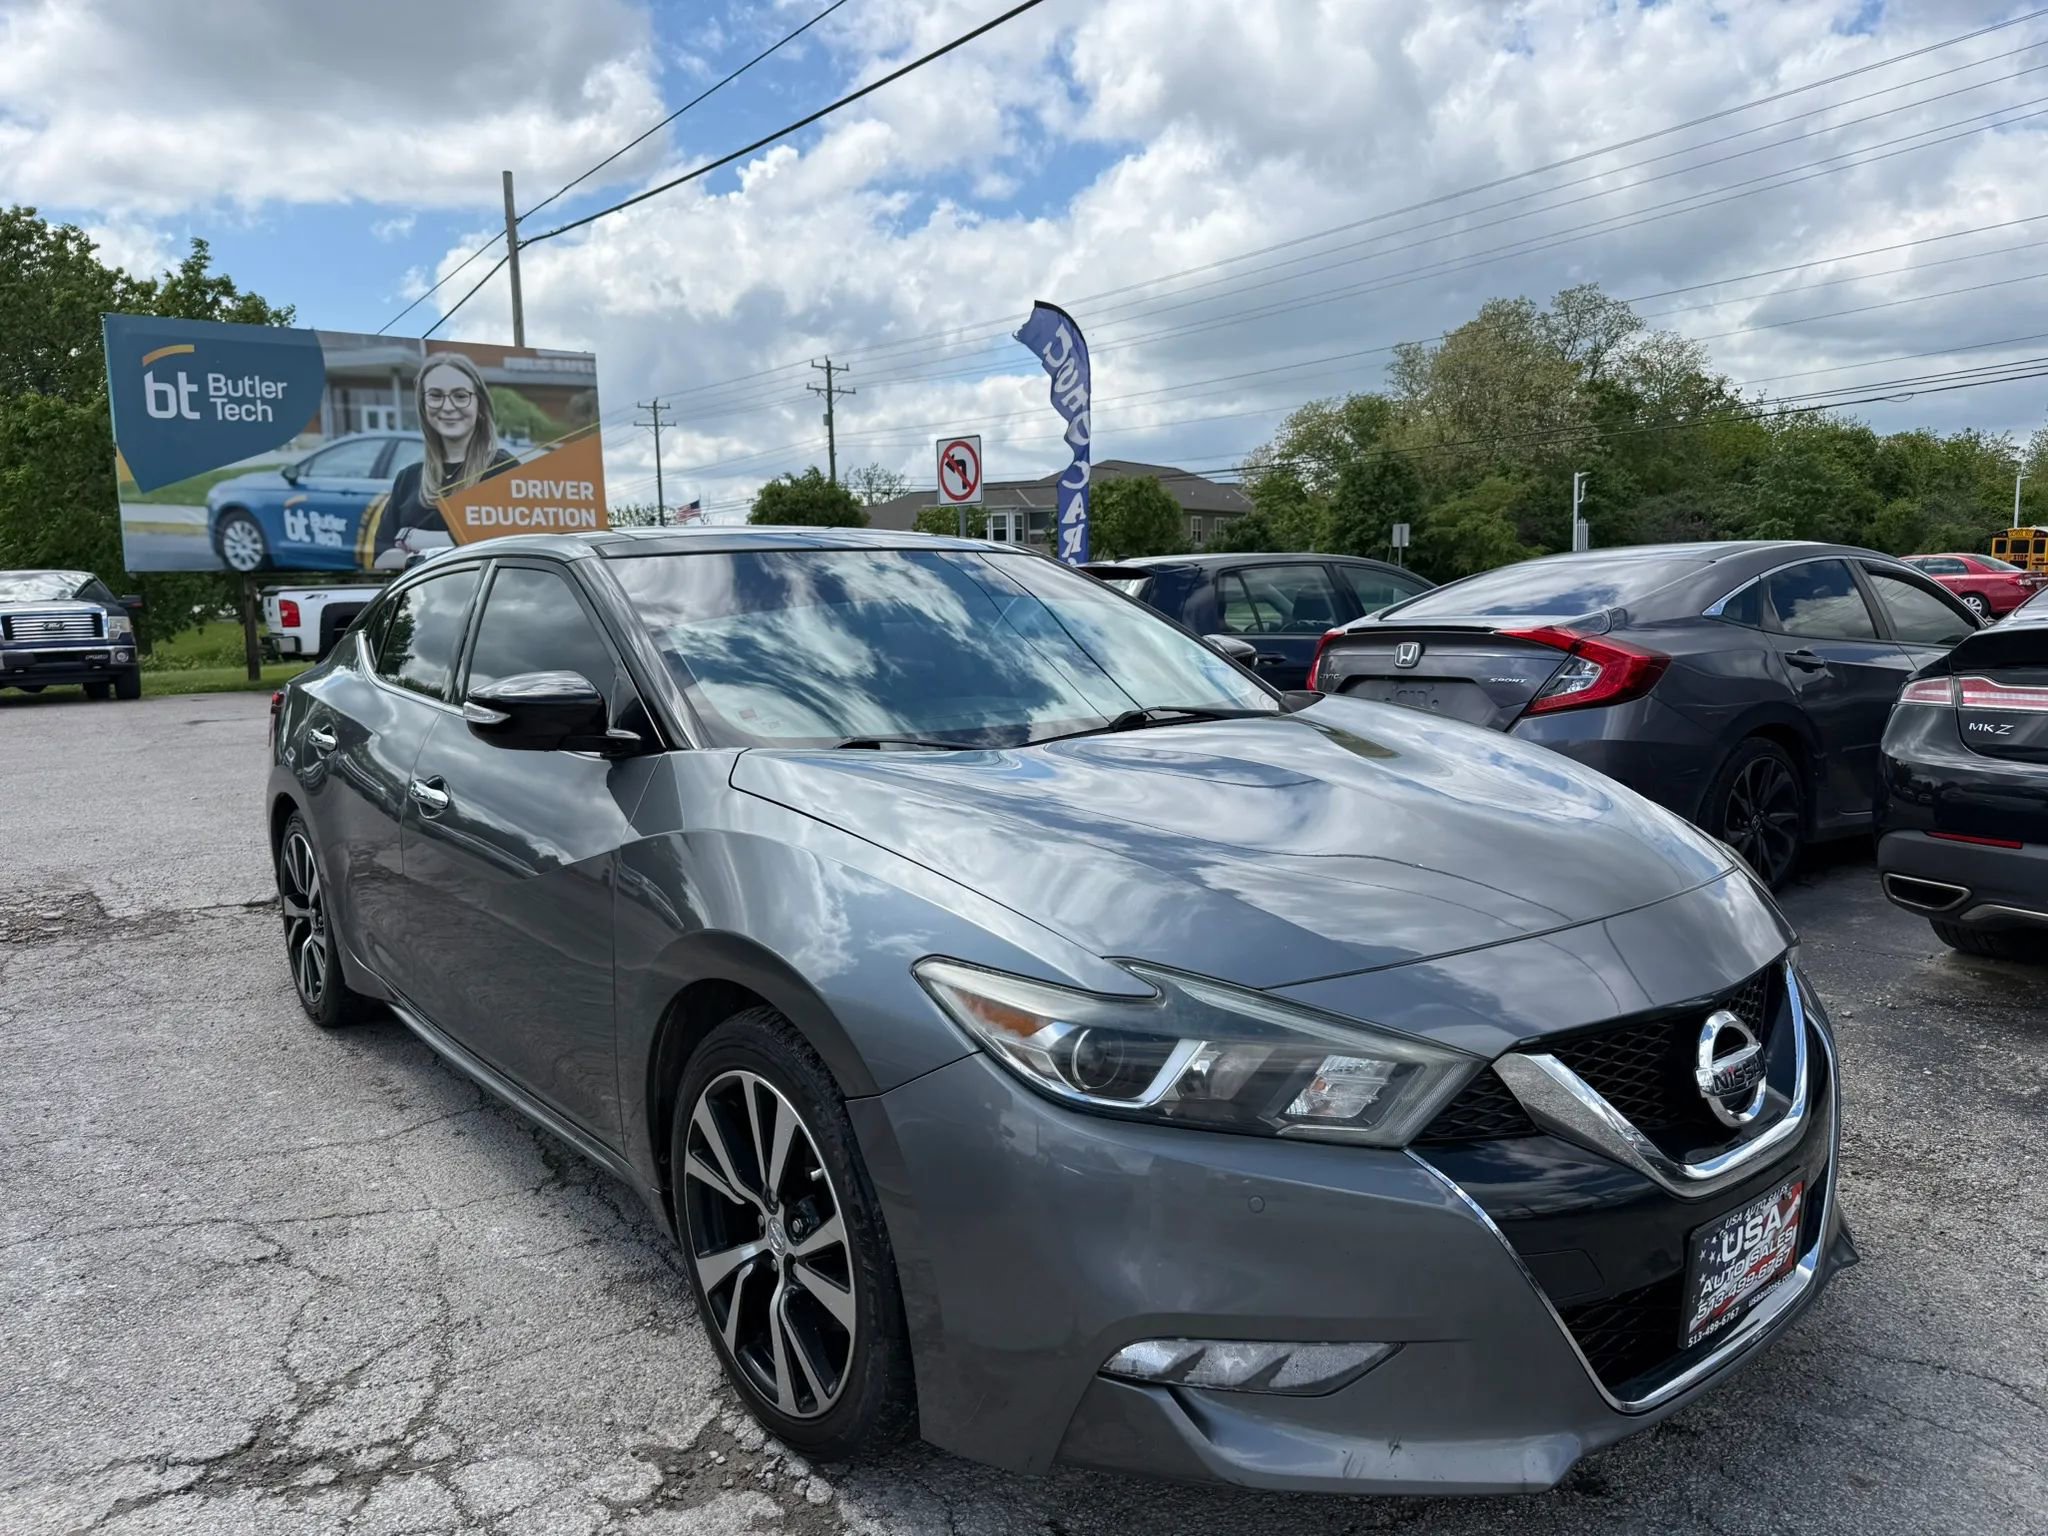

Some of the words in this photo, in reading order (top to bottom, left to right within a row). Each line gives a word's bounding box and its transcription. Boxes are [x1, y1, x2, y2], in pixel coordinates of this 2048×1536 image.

[143, 370, 200, 420] bt
[207, 372, 288, 400] Butler
[209, 397, 274, 423] Tech
[510, 479, 595, 501] DRIVER
[464, 505, 597, 528] EDUCATION
[1488, 676, 1528, 685] SPORT
[1721, 1204, 1782, 1263] USA
[1725, 1211, 1743, 1230] USA
[1701, 1258, 1746, 1297] AUTO
[1749, 1226, 1794, 1267] SALES
